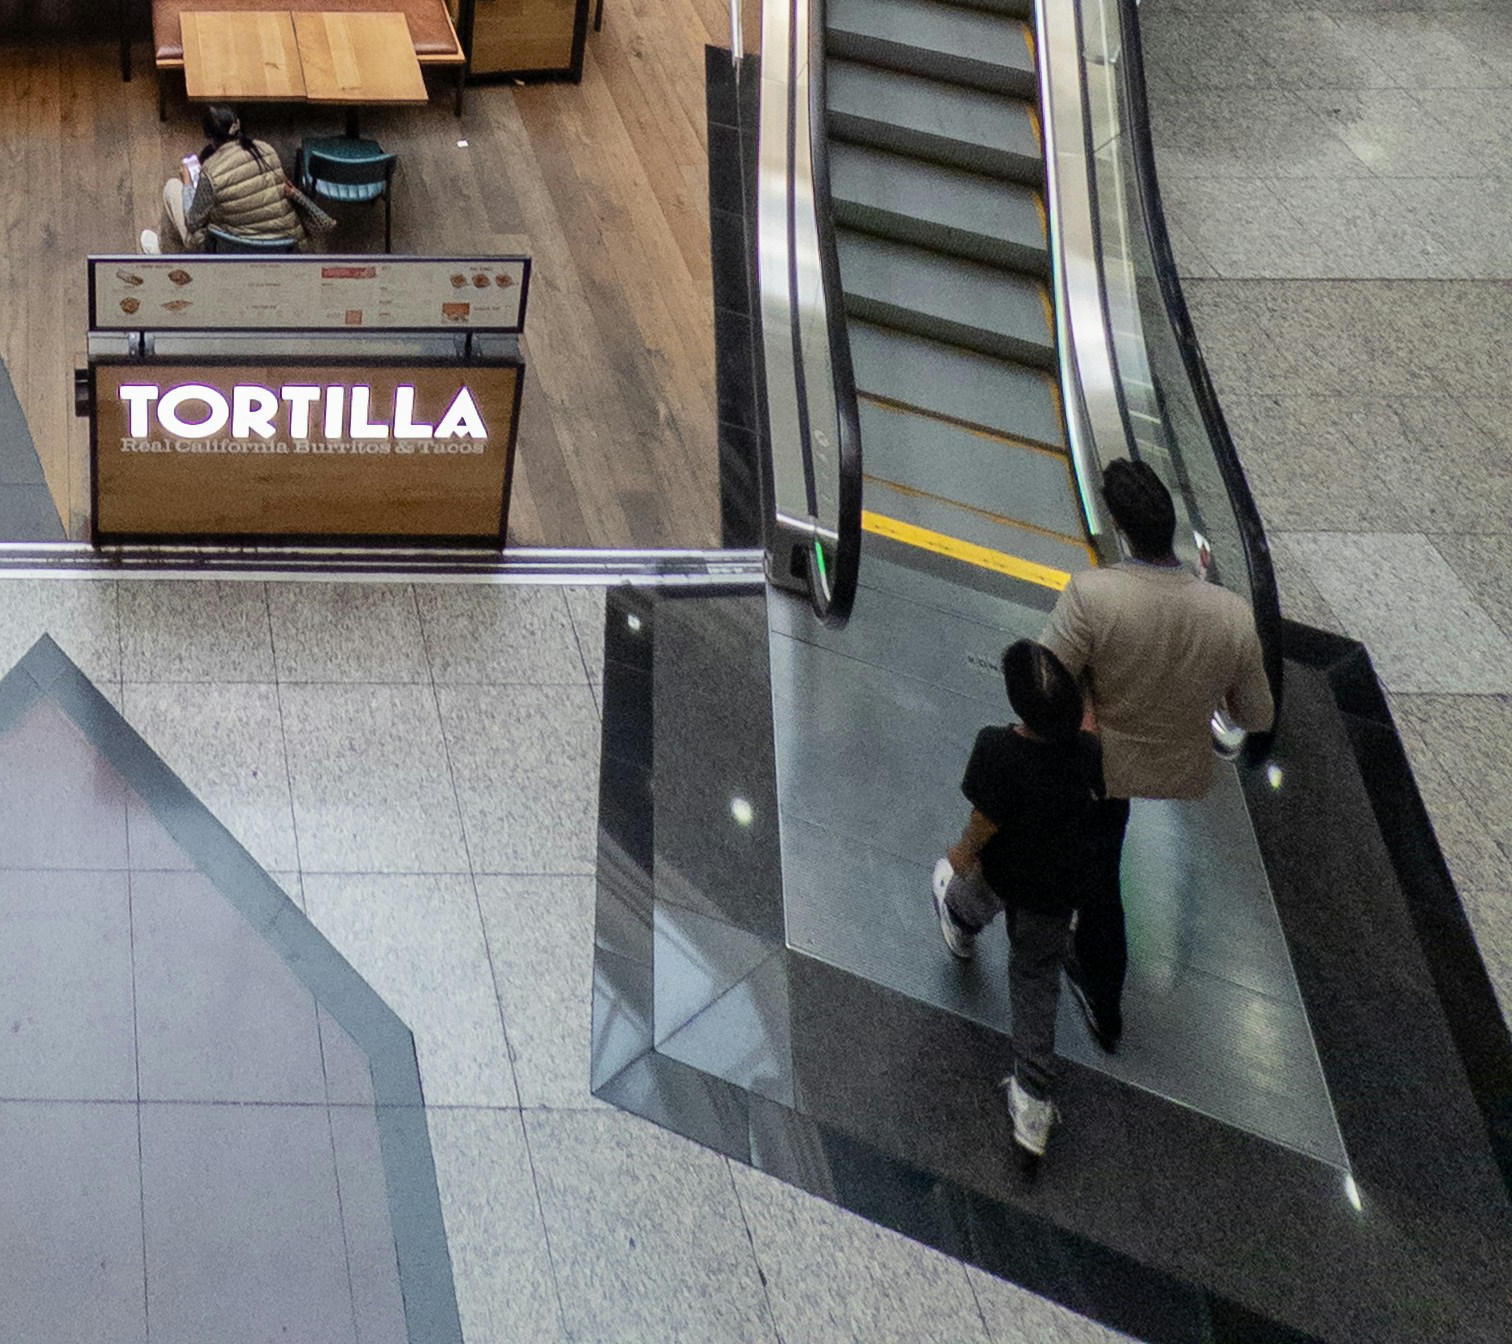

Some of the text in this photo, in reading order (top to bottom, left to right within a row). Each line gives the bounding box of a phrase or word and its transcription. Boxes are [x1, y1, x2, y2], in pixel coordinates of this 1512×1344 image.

[119, 384, 488, 439] TORTILLA
[120, 438, 486, 454] Real California Burritos & Tacos
